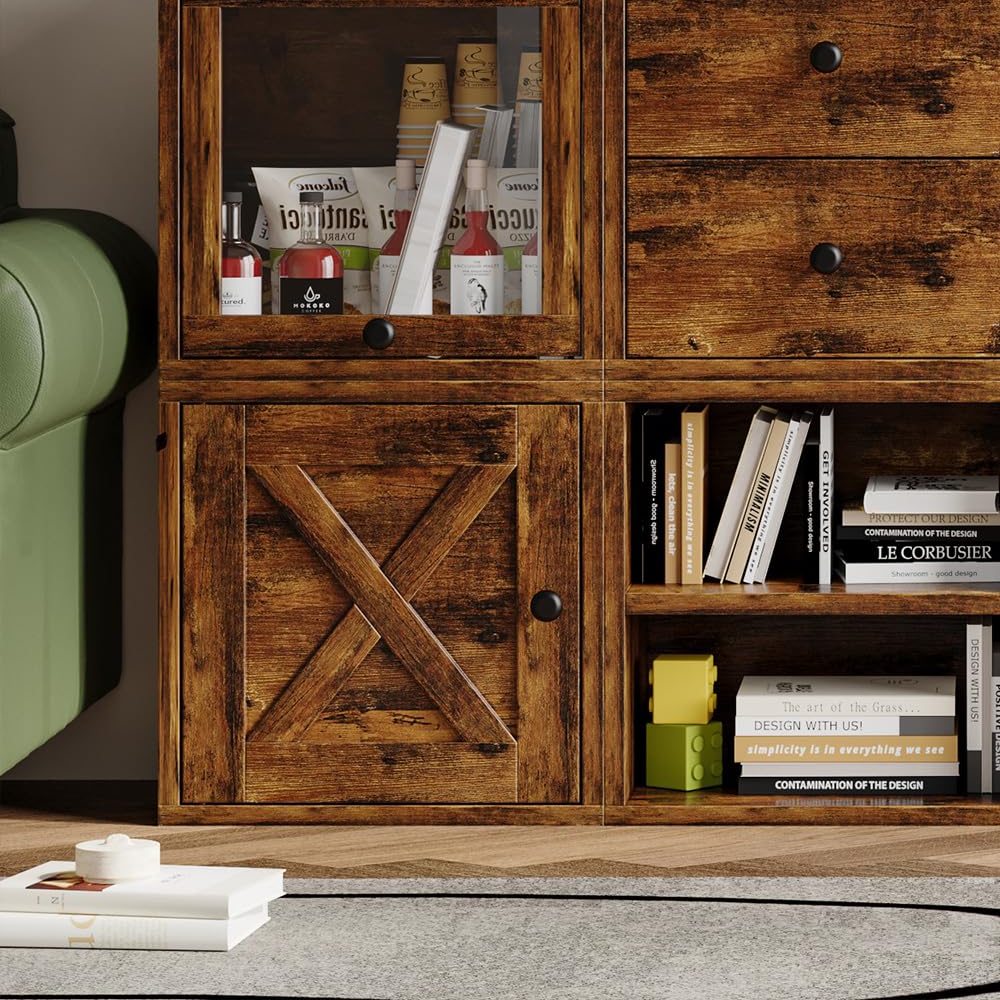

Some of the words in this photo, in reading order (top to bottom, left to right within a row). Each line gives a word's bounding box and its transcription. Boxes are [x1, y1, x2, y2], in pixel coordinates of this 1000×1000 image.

[667, 495, 677, 521] clean
[744, 472, 771, 533] MINIMALISM
[686, 493, 695, 541] everything
[806, 517, 814, 532] good
[869, 513, 919, 524] PROTECT
[921, 514, 945, 524] OUR
[948, 514, 989, 524] DESIGN
[667, 524, 677, 540] the
[864, 528, 924, 537] CONTAMINATION
[925, 529, 935, 537] OF
[936, 529, 950, 537] THE
[951, 529, 978, 538] DESIGN
[667, 541, 677, 556] air
[806, 533, 814, 553] design
[877, 546, 897, 560] LE
[901, 545, 992, 560] CORBUSIER
[935, 570, 953, 579] good
[954, 569, 978, 578] design
[971, 639, 979, 675] DESIGN
[971, 678, 979, 704] WITH
[782, 701, 801, 713] The
[806, 702, 824, 713] art
[830, 701, 842, 713] of
[850, 701, 868, 713] the
[872, 701, 921, 713] Grass...
[971, 706, 979, 723] US!
[754, 720, 802, 731] DESIGN
[805, 720, 839, 731] WITH
[842, 720, 864, 731] US!
[747, 743, 807, 757] simplicity
[809, 743, 821, 755] is
[824, 743, 836, 755] in
[839, 743, 903, 757] everything
[905, 745, 922, 755] we
[924, 745, 945, 755] see
[775, 780, 853, 791] CONTAMINATION
[854, 780, 868, 791] OF
[870, 780, 887, 791] THE
[888, 780, 924, 791] DESIGN
